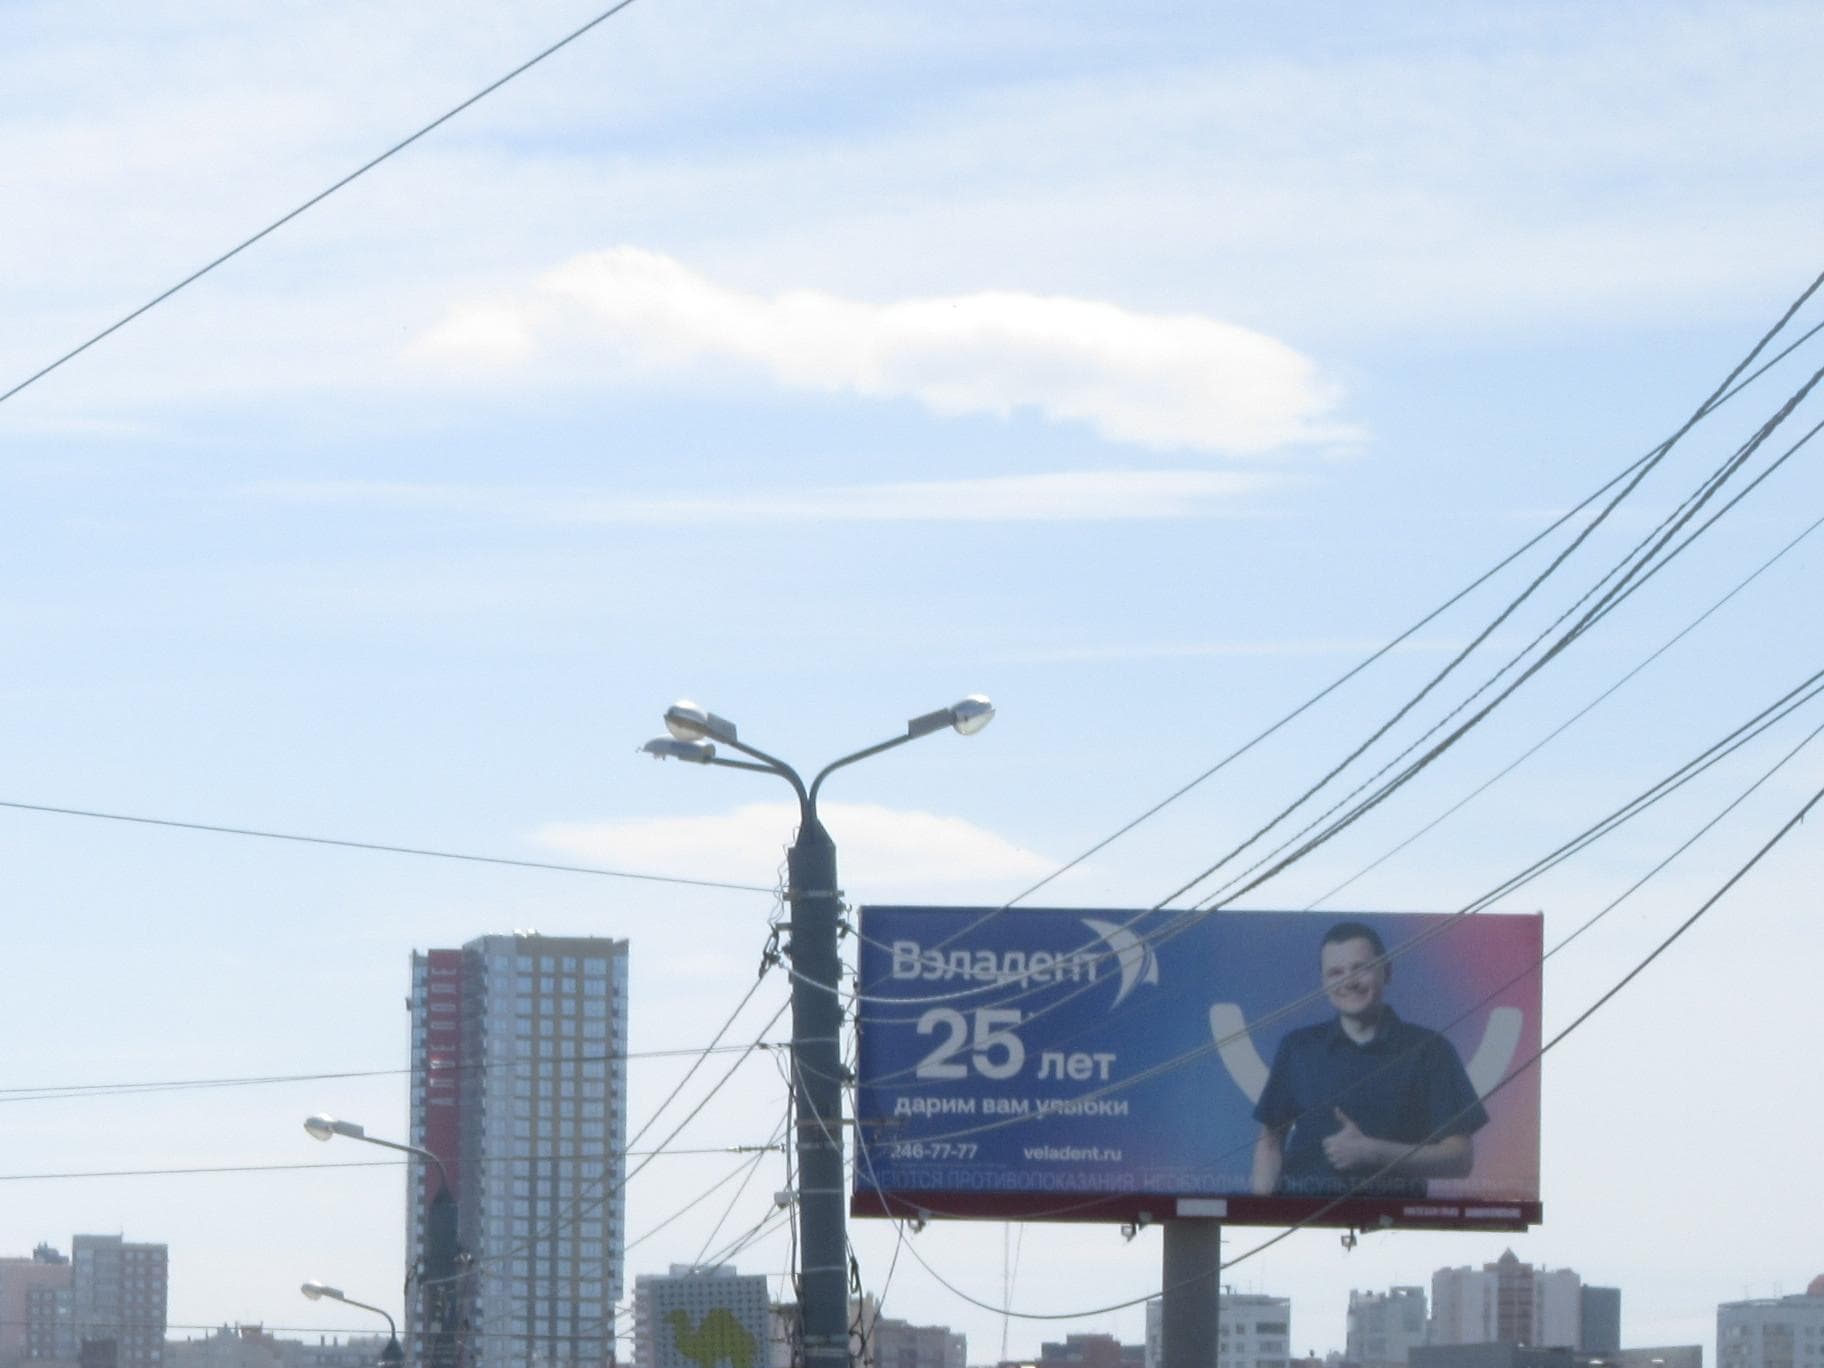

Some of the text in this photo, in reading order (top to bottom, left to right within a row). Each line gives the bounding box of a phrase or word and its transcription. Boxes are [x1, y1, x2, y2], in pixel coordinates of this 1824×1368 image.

[891, 940, 1100, 988] Вэладент
[916, 1007, 1117, 1080] 25 лет
[893, 1096, 975, 1118] дарим
[982, 1097, 1028, 1115] вам
[1023, 1145, 1123, 1162] veladent.ru
